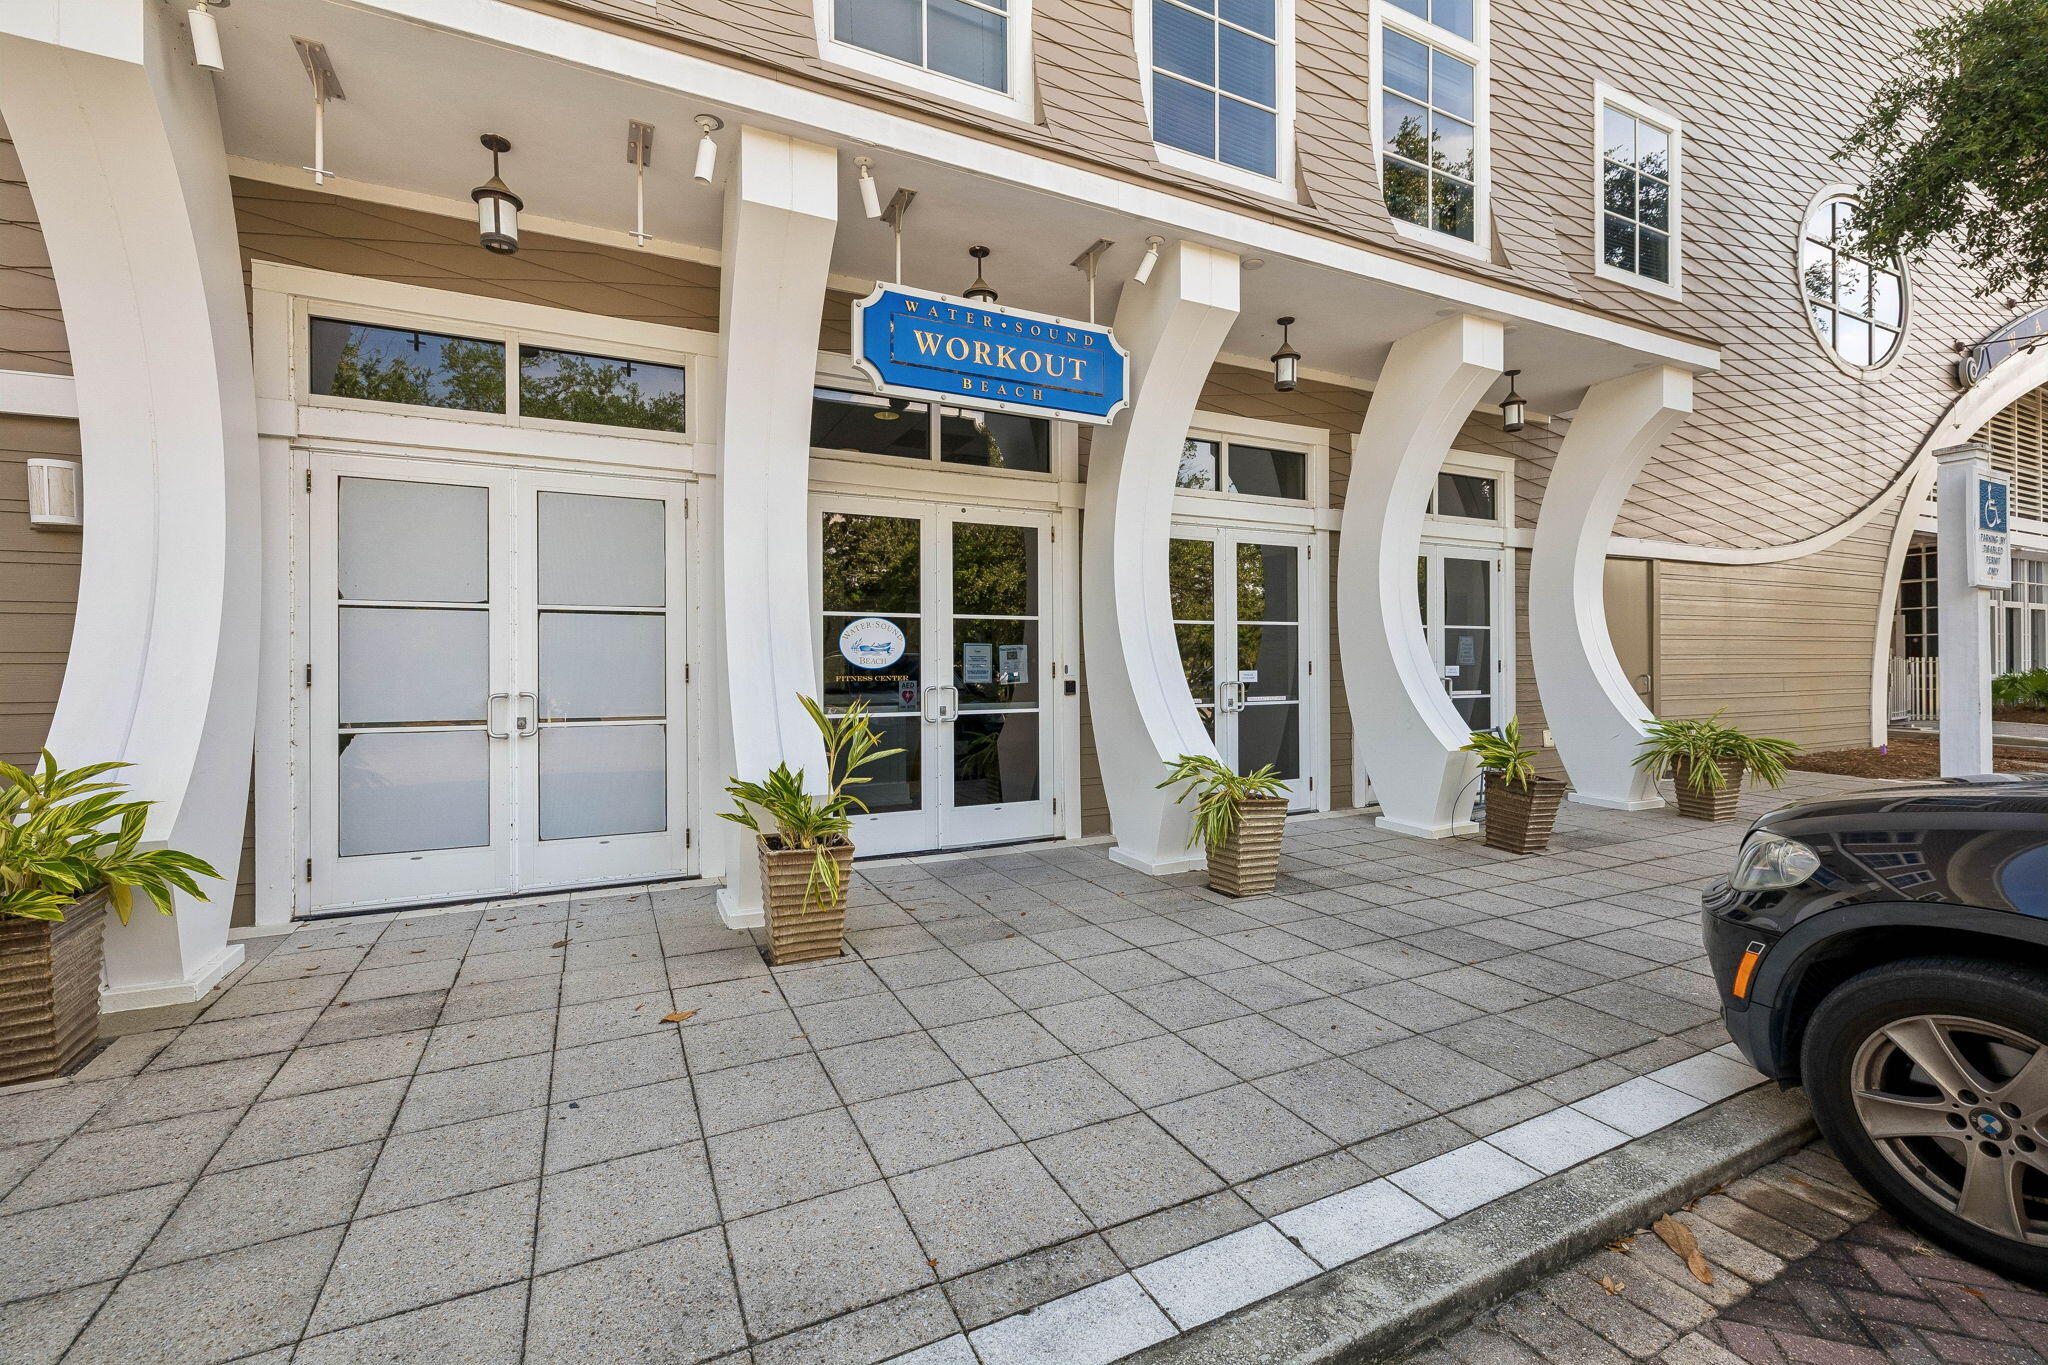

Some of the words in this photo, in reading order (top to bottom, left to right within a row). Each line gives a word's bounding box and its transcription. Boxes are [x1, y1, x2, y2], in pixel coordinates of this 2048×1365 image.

[913, 329, 1087, 381] WORKOUT
[962, 377, 1043, 401] BEACH
[859, 656, 887, 665] BEACH
